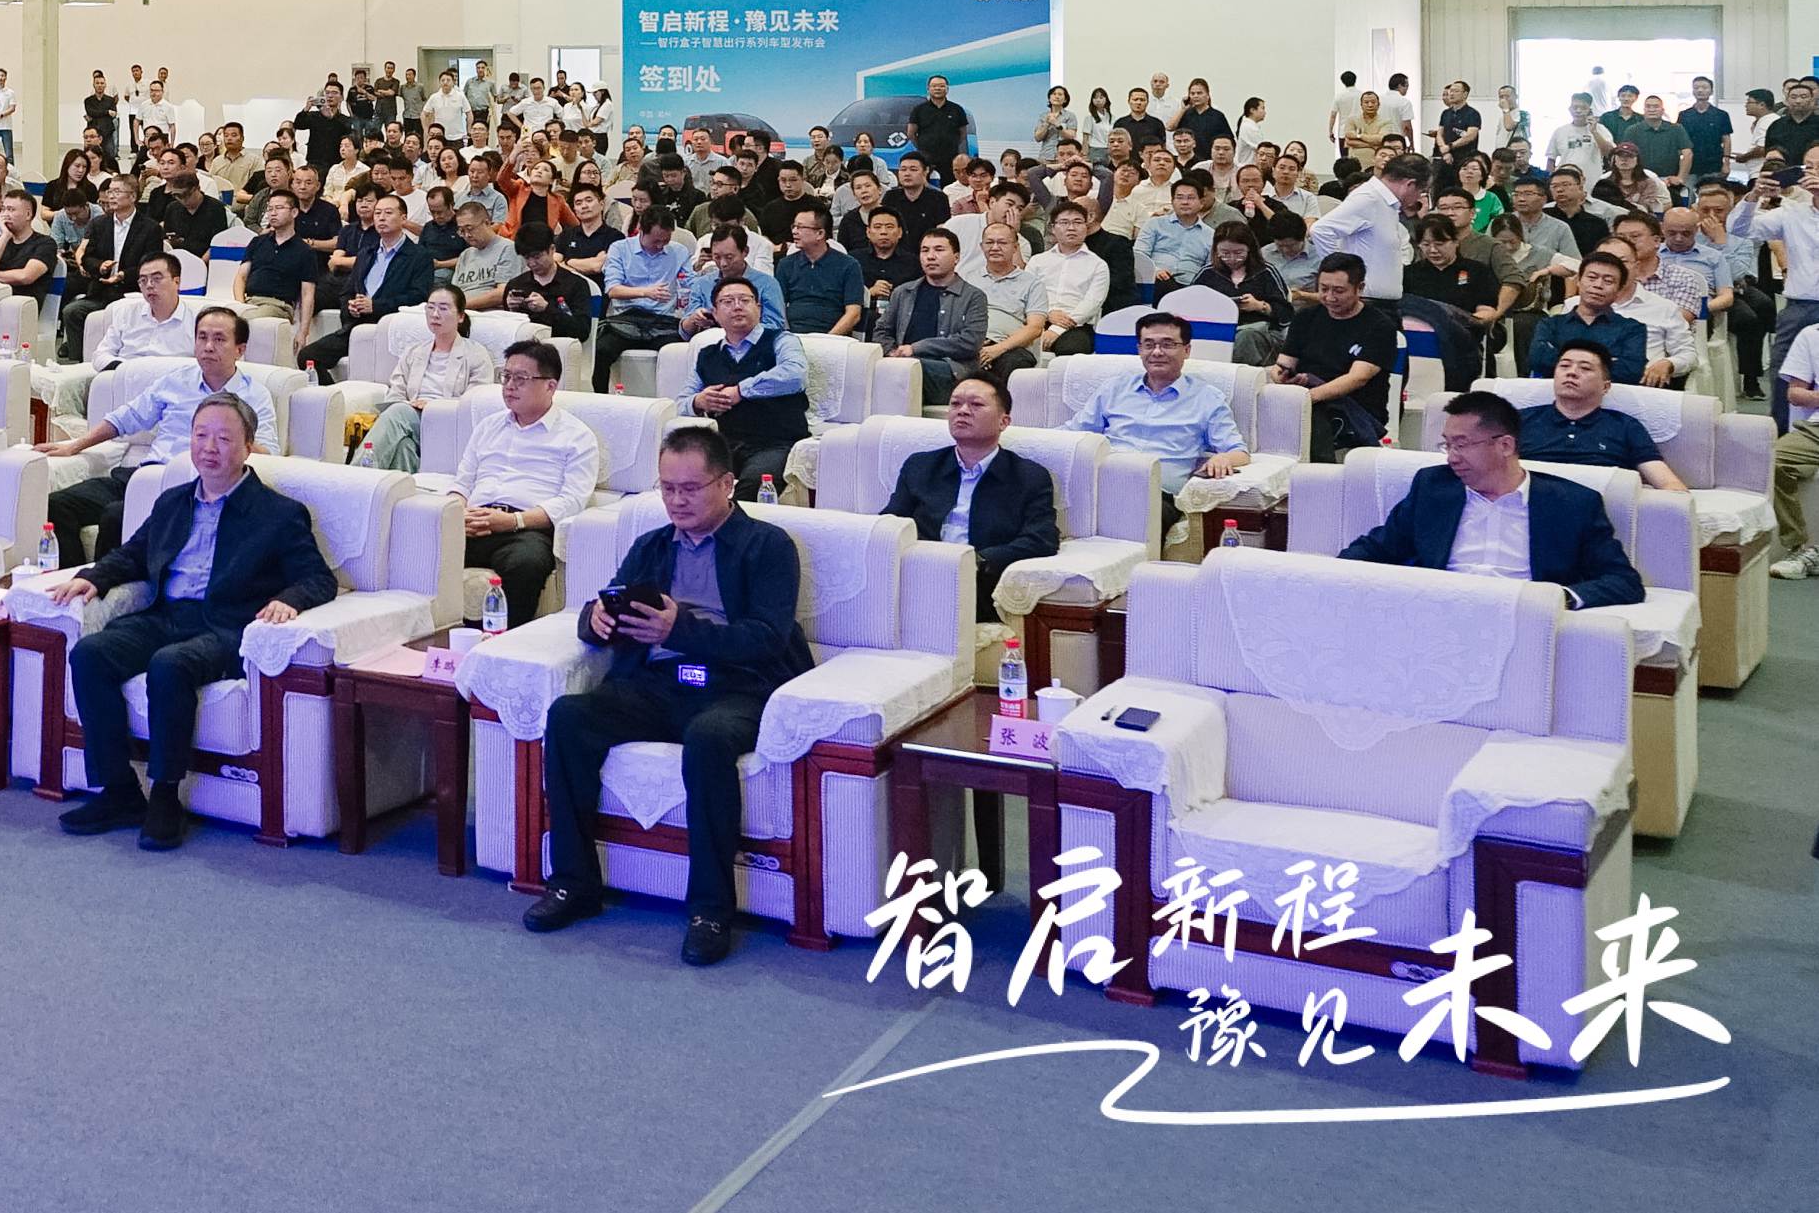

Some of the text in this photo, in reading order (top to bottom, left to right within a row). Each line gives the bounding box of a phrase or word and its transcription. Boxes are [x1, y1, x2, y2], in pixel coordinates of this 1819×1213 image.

[638, 9, 840, 33] 智启新程·豫见未来
[639, 64, 722, 93] 签到处
